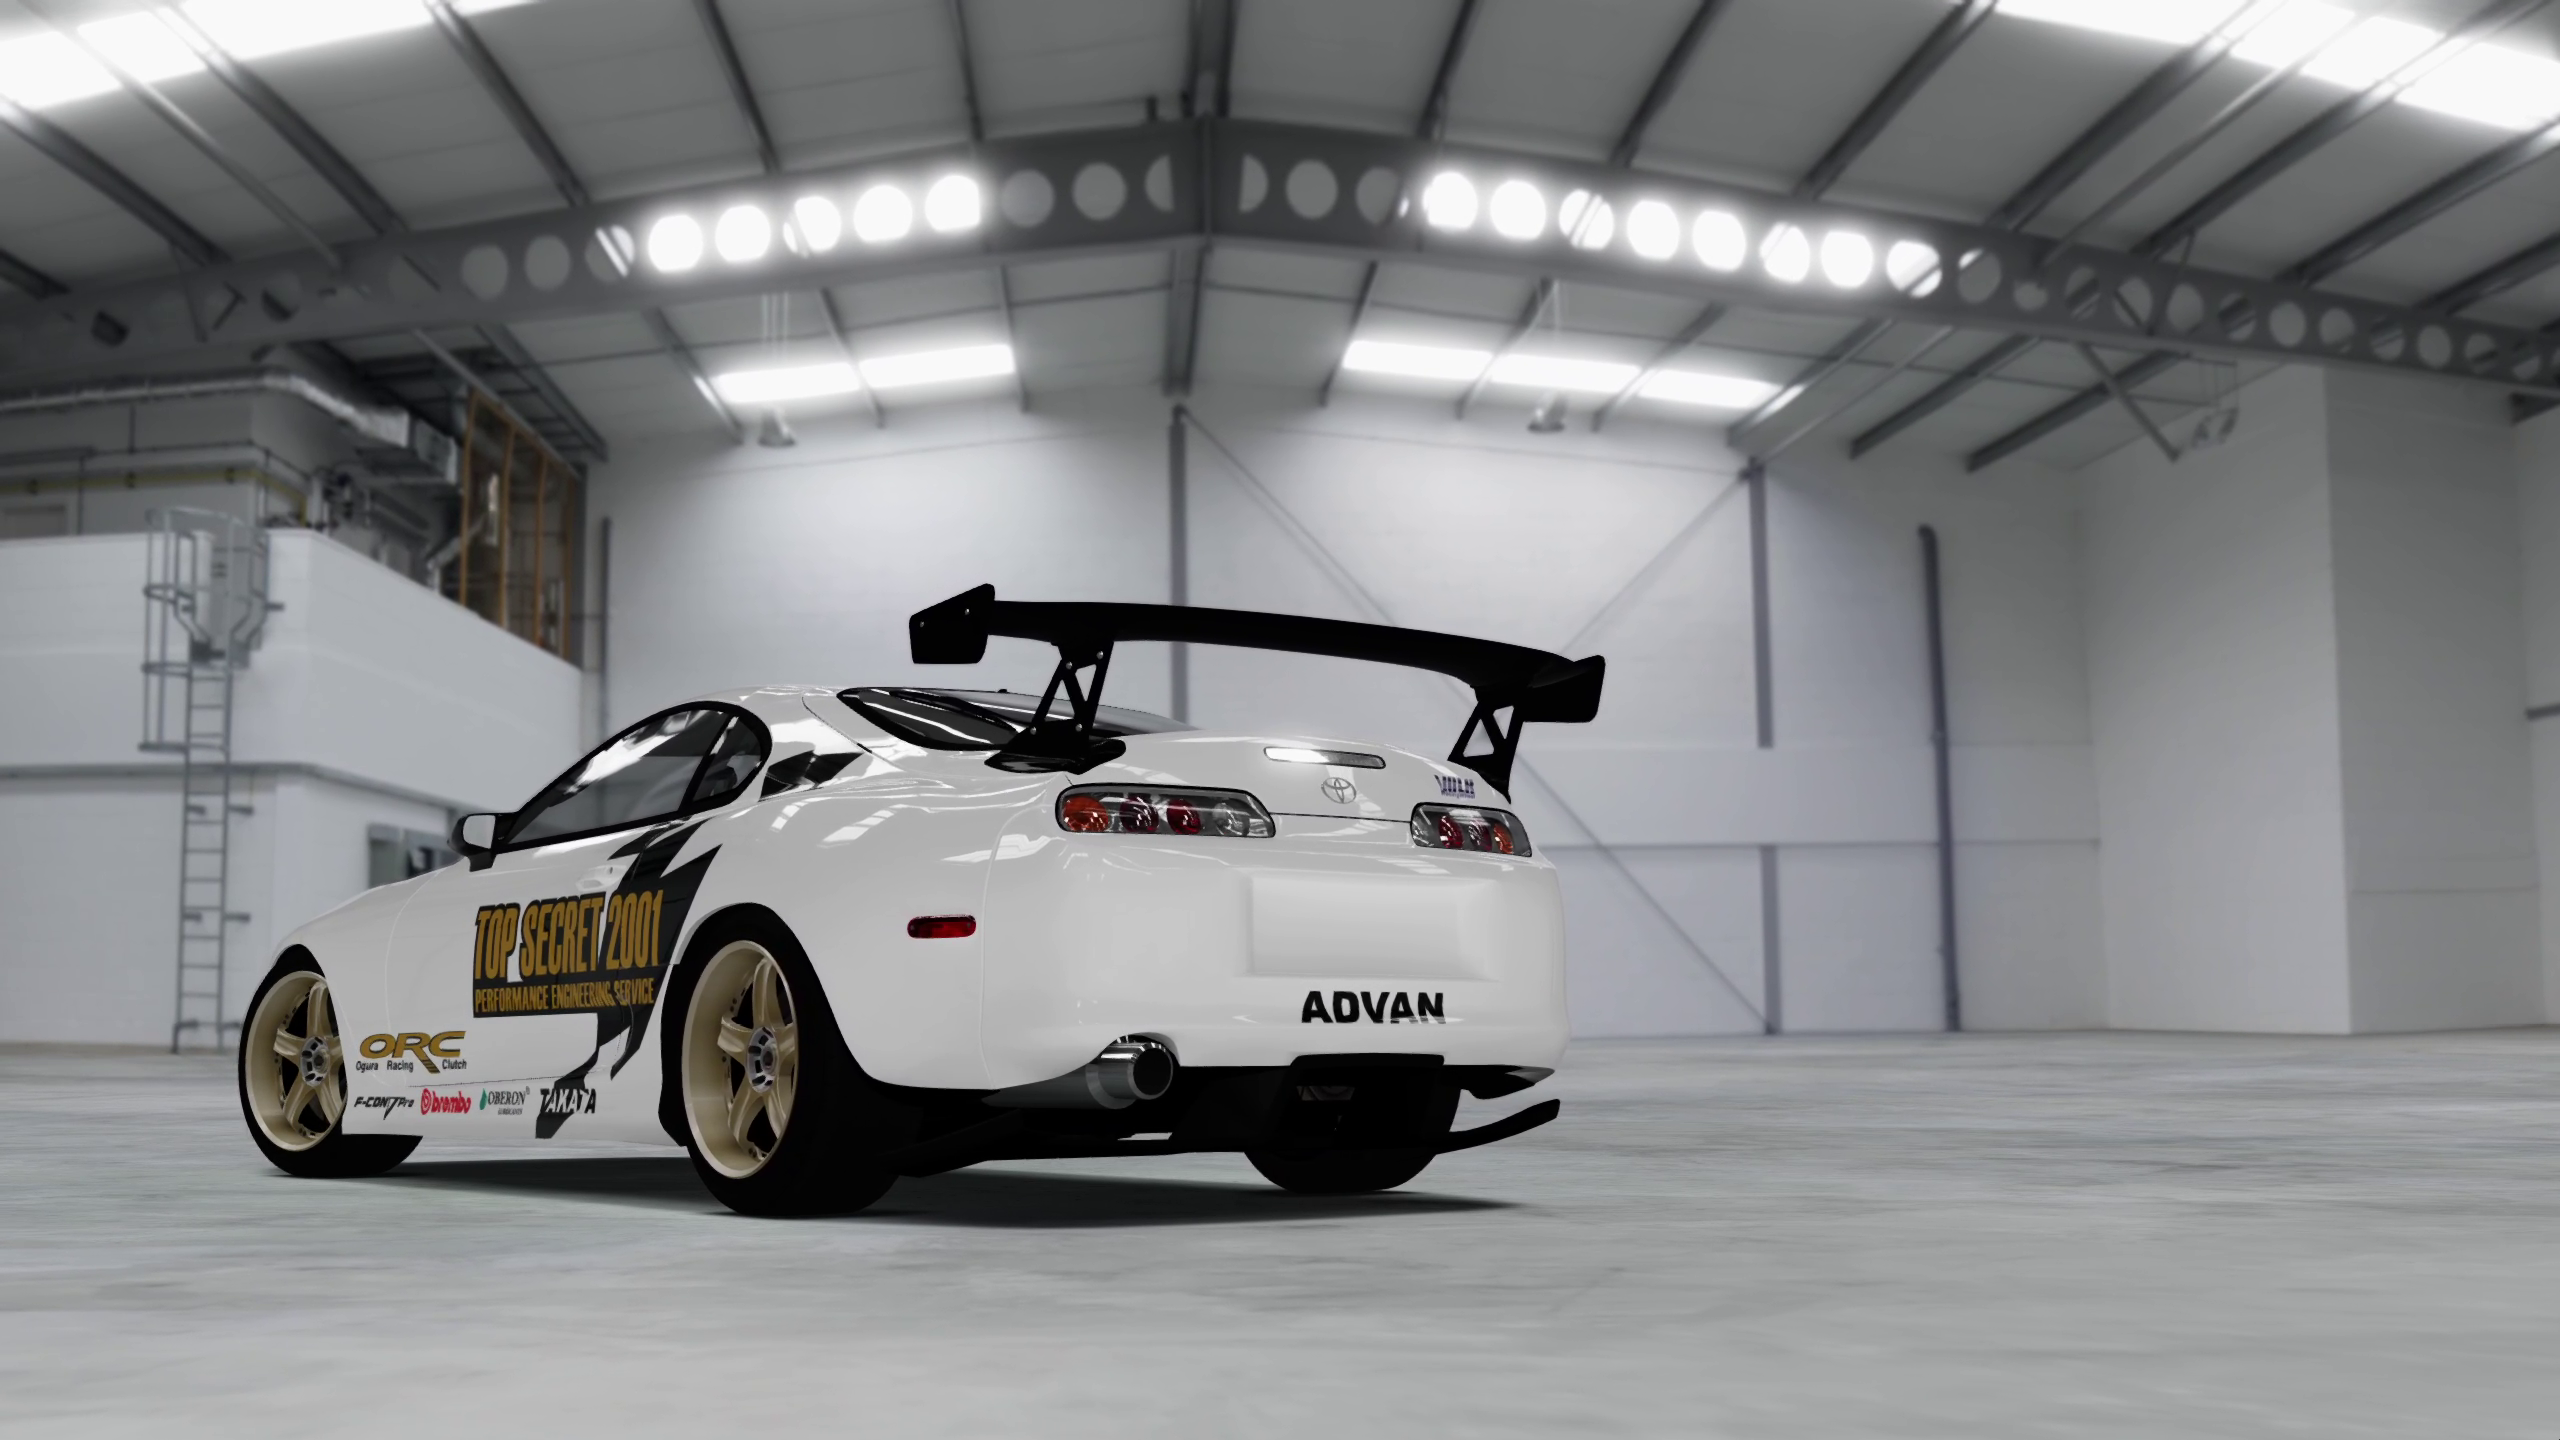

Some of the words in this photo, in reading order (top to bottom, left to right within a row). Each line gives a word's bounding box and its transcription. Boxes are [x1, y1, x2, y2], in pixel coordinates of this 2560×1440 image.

[475, 906, 519, 979] TOP
[520, 897, 604, 977] SECRET
[606, 889, 664, 970] 2001
[475, 985, 549, 1013] PERFORMANCE
[551, 981, 616, 1009] ENGINEERING
[613, 978, 654, 1006] SERVICE
[1301, 991, 1446, 1024] ADVAN
[355, 1061, 379, 1073] Ogura
[386, 1060, 414, 1073] Racing
[442, 1059, 467, 1070] Clutch
[360, 1031, 466, 1074] ORC
[431, 1090, 472, 1114] brembo
[487, 1090, 526, 1105] OBERON
[540, 1088, 597, 1114] TAKATA
